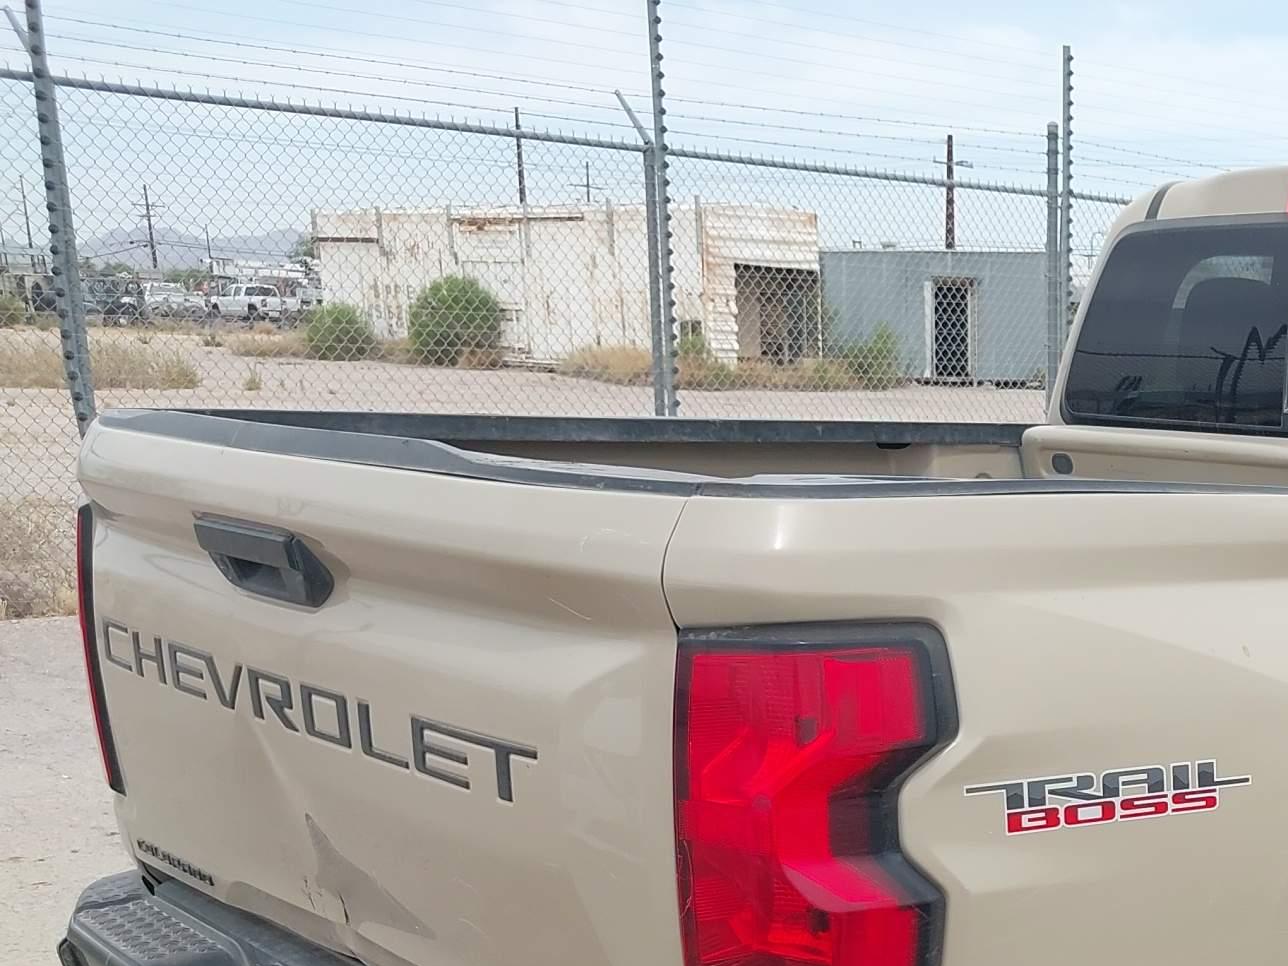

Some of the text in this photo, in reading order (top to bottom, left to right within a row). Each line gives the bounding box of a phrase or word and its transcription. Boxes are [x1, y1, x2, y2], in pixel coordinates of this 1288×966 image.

[102, 617, 538, 803] CHEVROLET
[964, 760, 1251, 811] TRAIL
[1006, 788, 1218, 835] BOSS
